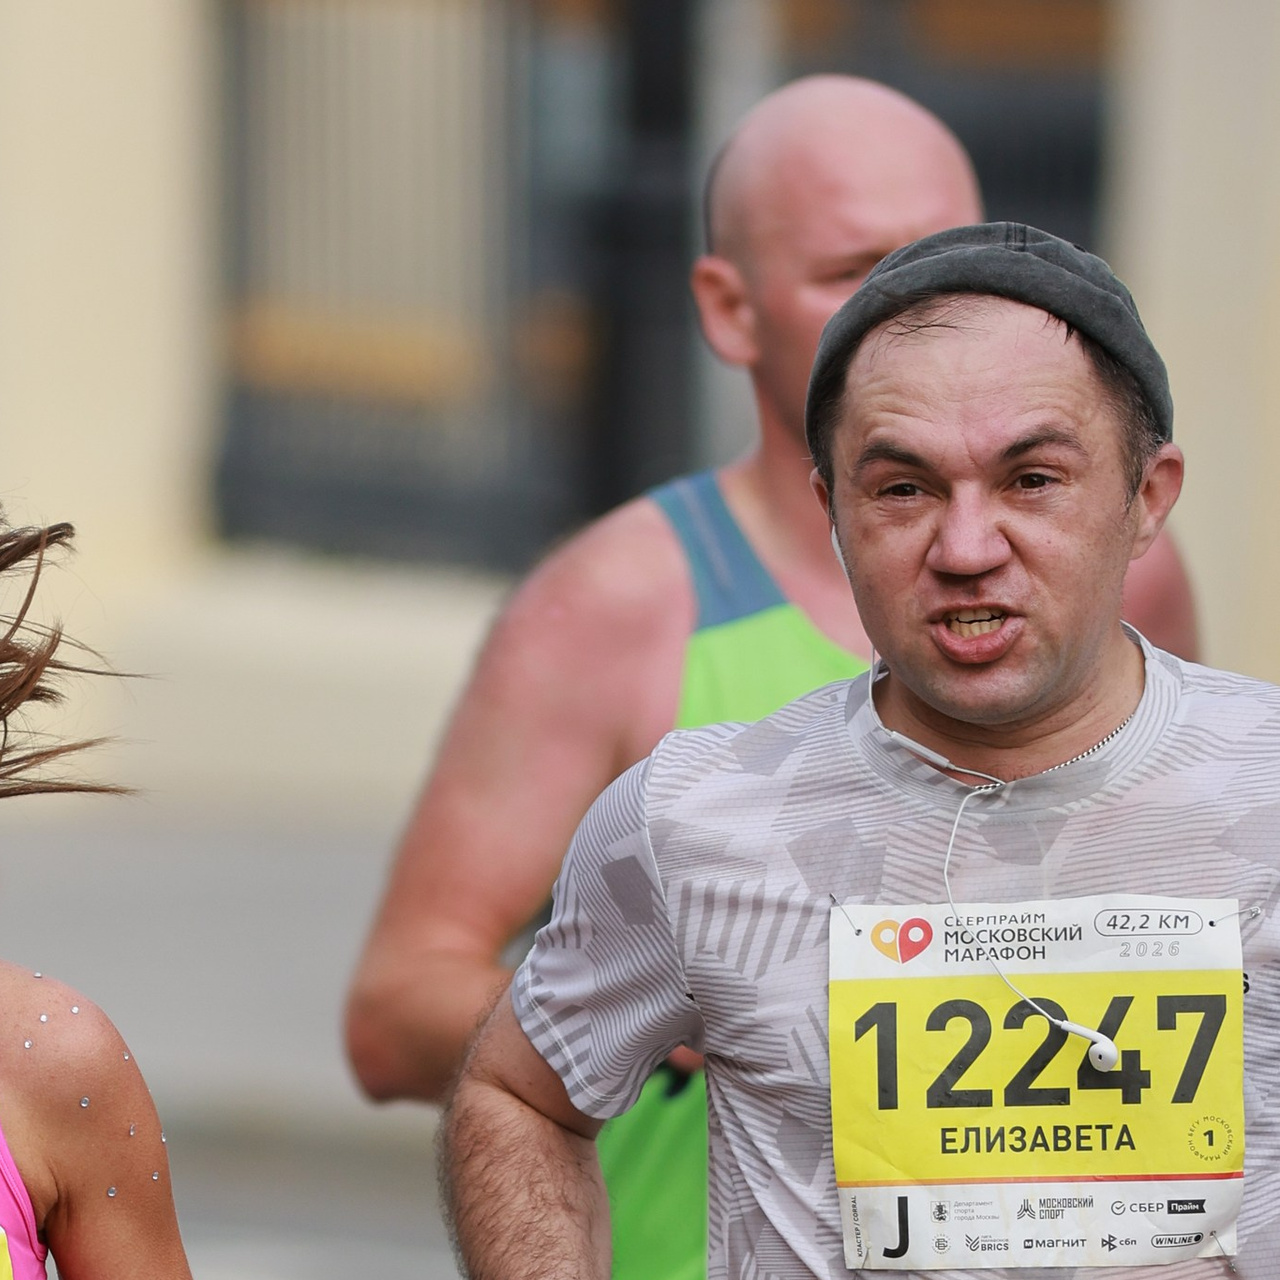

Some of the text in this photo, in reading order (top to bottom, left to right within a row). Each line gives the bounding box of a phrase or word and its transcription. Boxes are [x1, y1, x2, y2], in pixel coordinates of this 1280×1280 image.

[944, 912, 1045, 927] СБЕРПРАЙМ
[1106, 914, 1189, 932] 42,2 КМ
[944, 924, 1082, 945] МОСКОВСКИЙ
[944, 946, 1046, 962] МАРАФОН
[1120, 941, 1180, 957] 2026
[854, 994, 1227, 1110] 12247
[941, 1123, 1136, 1154] ЕЛИЗАВЕТА
[1203, 1130, 1214, 1146] 1
[851, 1195, 859, 1222] CORRAL
[1039, 1195, 1094, 1209] МОСКОВСКИЙ
[1130, 1203, 1200, 1212] СБЕР Прайм
[1039, 1209, 1064, 1220] СПОРТ
[882, 1196, 909, 1258] J
[854, 1227, 863, 1257] КЛАСТЕР
[981, 1243, 1009, 1251] BRICS
[1155, 1235, 1193, 1245] WINLINE
